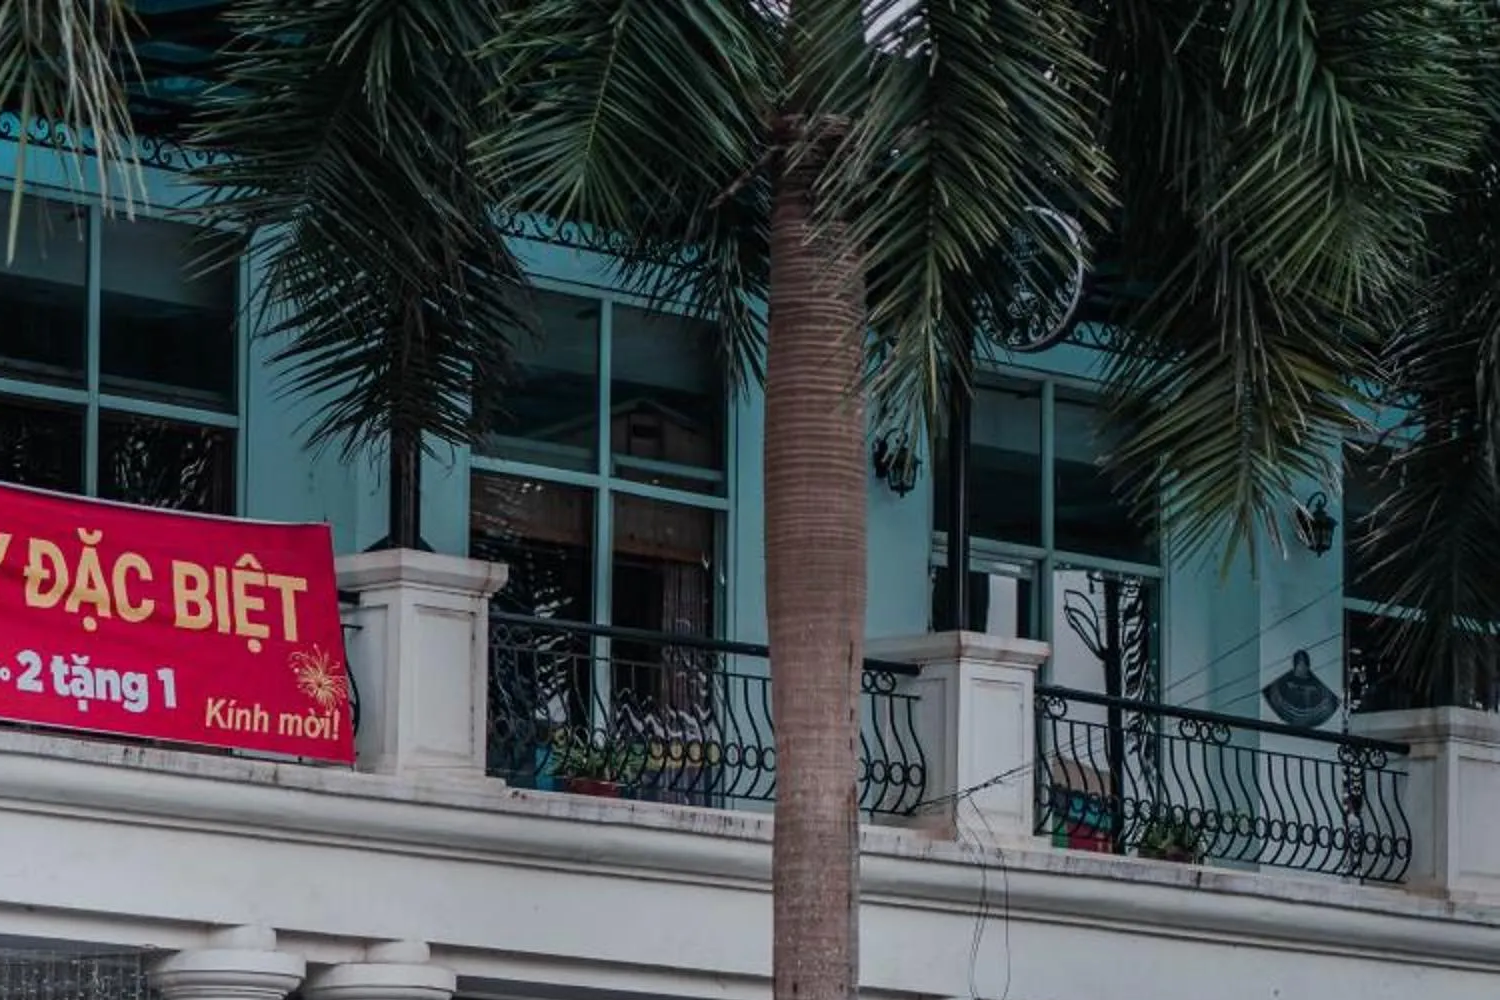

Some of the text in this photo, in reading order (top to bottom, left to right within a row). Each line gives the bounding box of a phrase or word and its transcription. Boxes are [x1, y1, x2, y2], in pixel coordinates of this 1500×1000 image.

[23, 528, 154, 632] ĐẶC
[172, 552, 308, 654] BIỆT
[16, 650, 44, 693] 2
[50, 653, 149, 713] tặng
[157, 667, 178, 709] 1
[205, 697, 341, 741] Kính mời!
